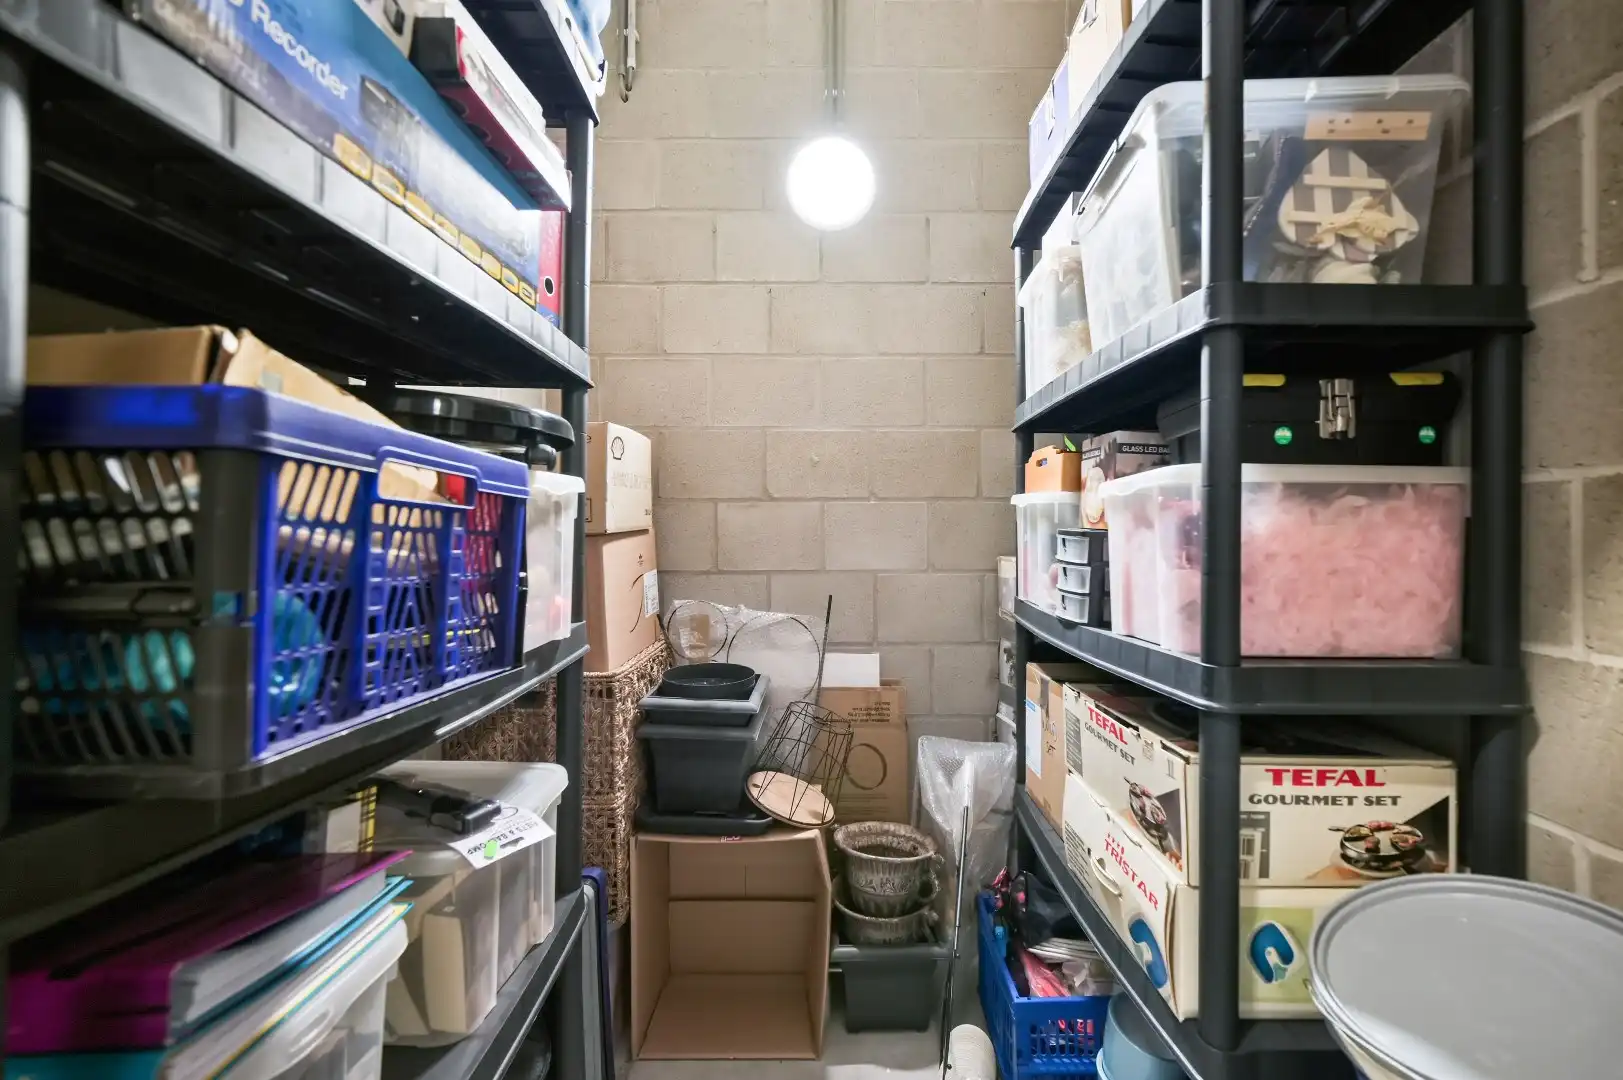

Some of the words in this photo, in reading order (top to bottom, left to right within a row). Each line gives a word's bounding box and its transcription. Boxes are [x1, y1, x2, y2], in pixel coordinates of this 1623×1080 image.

[251, 0, 349, 99] Recorder
[1121, 445, 1143, 453] GLASS
[1144, 446, 1158, 454] LED
[1084, 722, 1119, 753] GOURMET
[1119, 748, 1136, 767] SET
[1087, 705, 1129, 746] TEFAL
[1264, 768, 1387, 787] TEFAL
[1249, 793, 1359, 807] GOURMET
[1363, 795, 1403, 807] SET
[1105, 838, 1159, 912] TRISTAR
